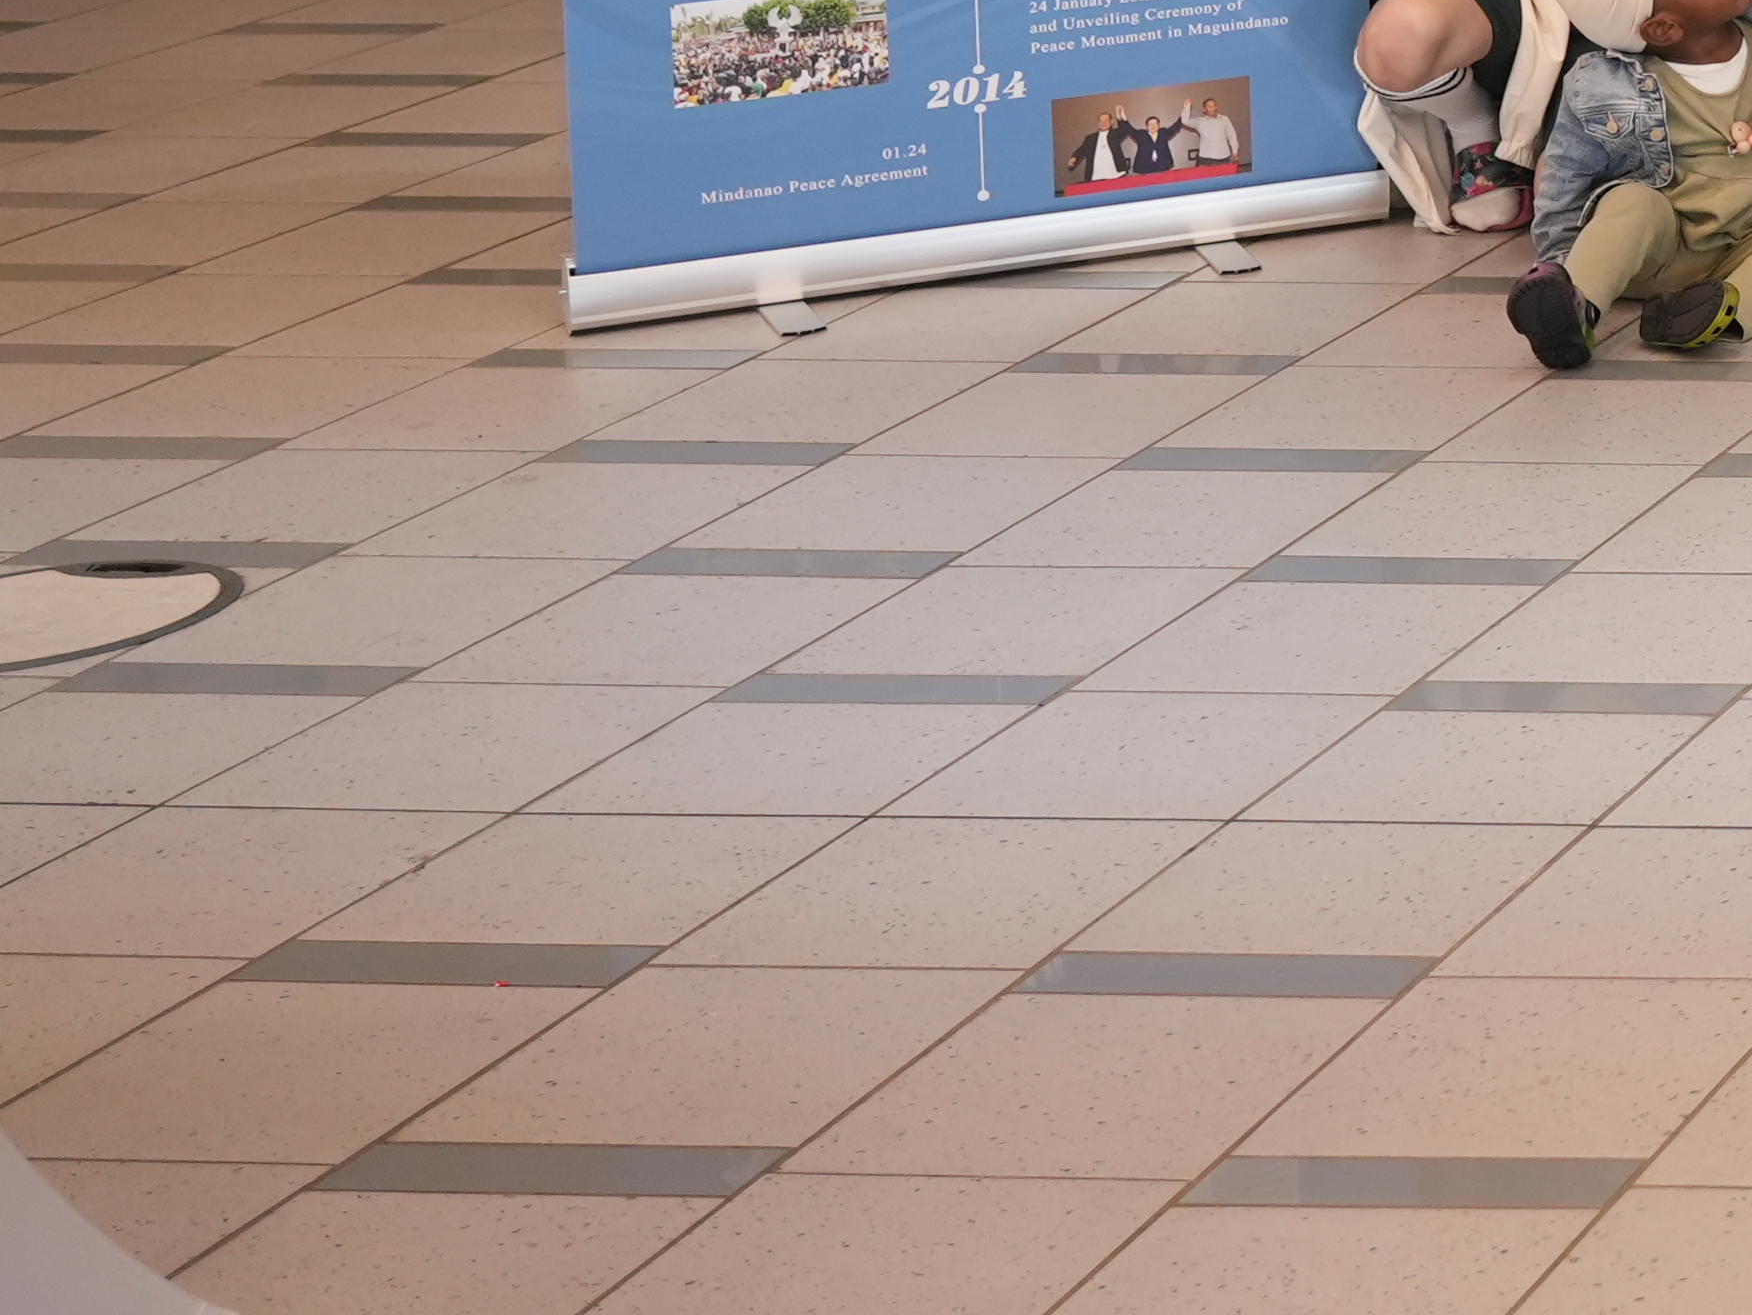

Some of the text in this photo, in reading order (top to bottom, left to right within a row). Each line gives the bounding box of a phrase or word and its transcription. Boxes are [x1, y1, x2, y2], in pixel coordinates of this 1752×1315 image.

[927, 71, 1028, 109] 2014
[883, 144, 927, 160] 01.24
[702, 166, 927, 204] Mindanao Peace Agreement
